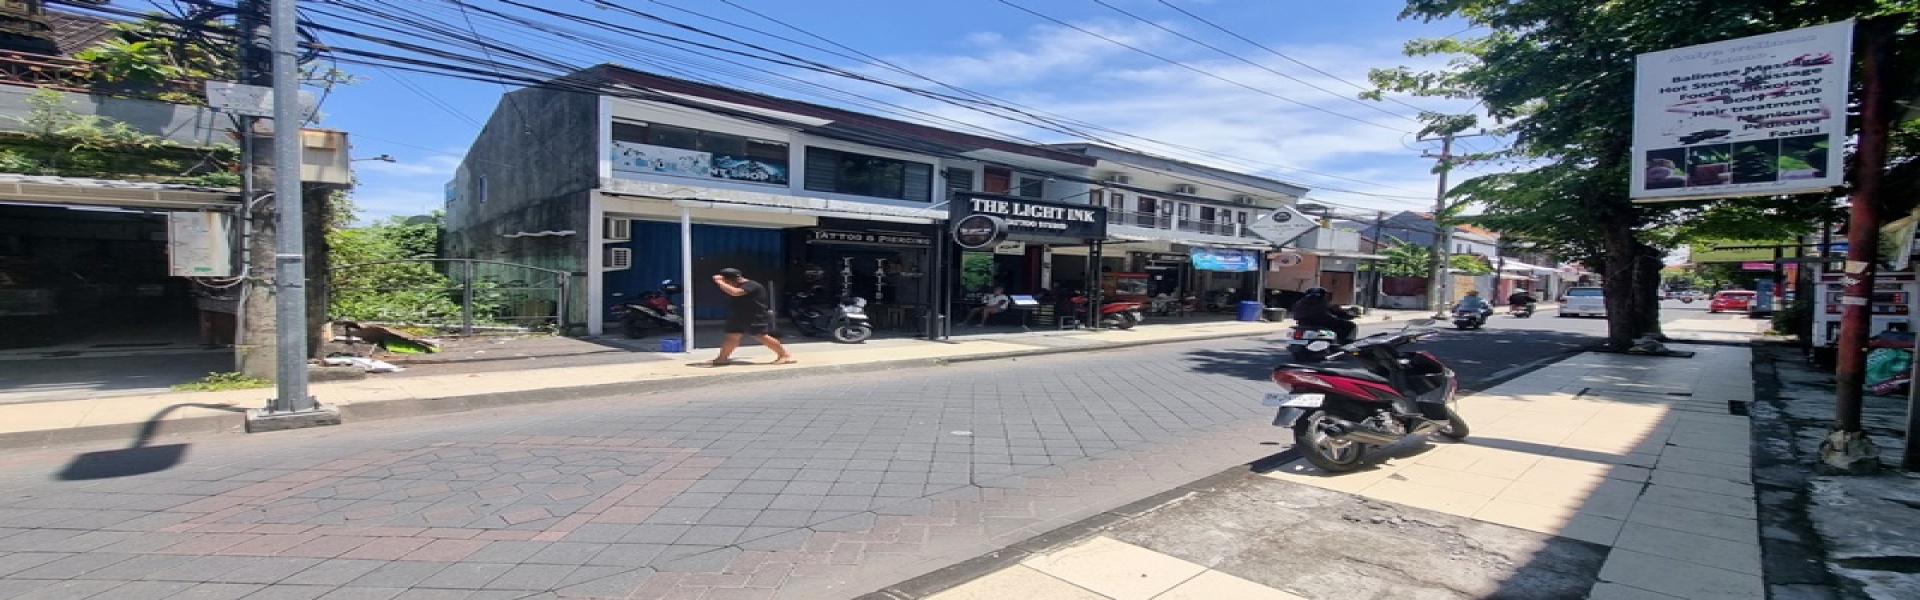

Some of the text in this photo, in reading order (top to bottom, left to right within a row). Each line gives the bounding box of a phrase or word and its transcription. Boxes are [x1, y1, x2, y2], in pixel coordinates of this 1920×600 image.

[1658, 68, 1823, 94] Hot Stone Massage
[1672, 69, 1740, 84] Balinese
[1679, 90, 1715, 101] Foot
[1692, 97, 1822, 117] Hair treatment
[1736, 107, 1820, 122] Manicure
[1743, 120, 1820, 130] Pedicure
[1769, 128, 1819, 137] Facial
[971, 199, 1095, 222] THE LIGHT INK
[815, 231, 862, 241] TATTOO
